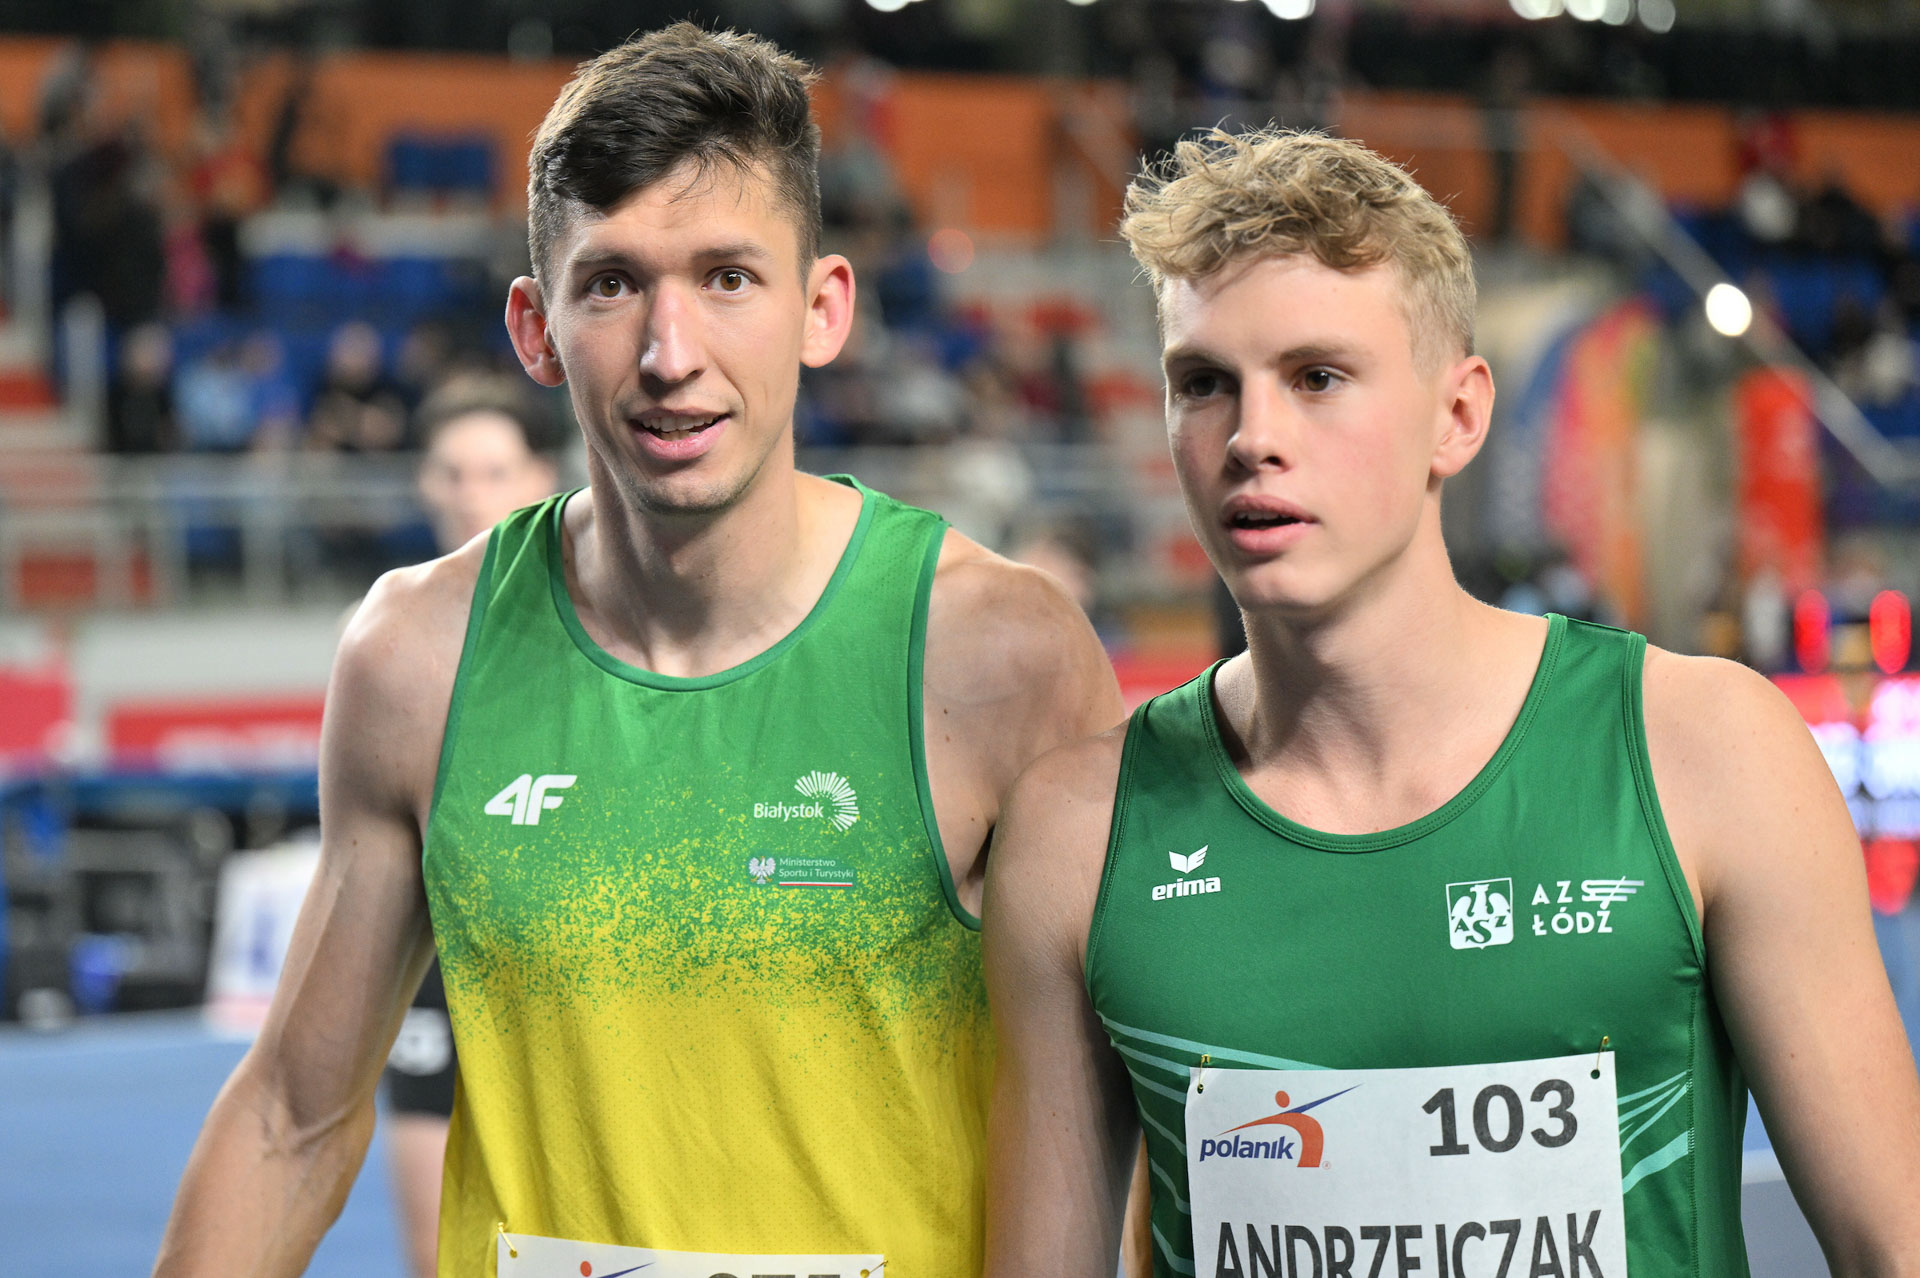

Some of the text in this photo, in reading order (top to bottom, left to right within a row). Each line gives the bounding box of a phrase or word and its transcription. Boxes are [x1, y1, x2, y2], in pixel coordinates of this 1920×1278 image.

[484, 773, 577, 825] 4F
[753, 801, 824, 822] Białystok
[779, 858, 836, 867] Ministerstwo
[779, 868, 808, 878] Sportu
[815, 868, 854, 879] Turystyki
[1152, 877, 1221, 901] erima
[1532, 906, 1613, 936] ŁÓDŹ
[1421, 1079, 1579, 1157] 103
[1199, 1134, 1295, 1162] polanik
